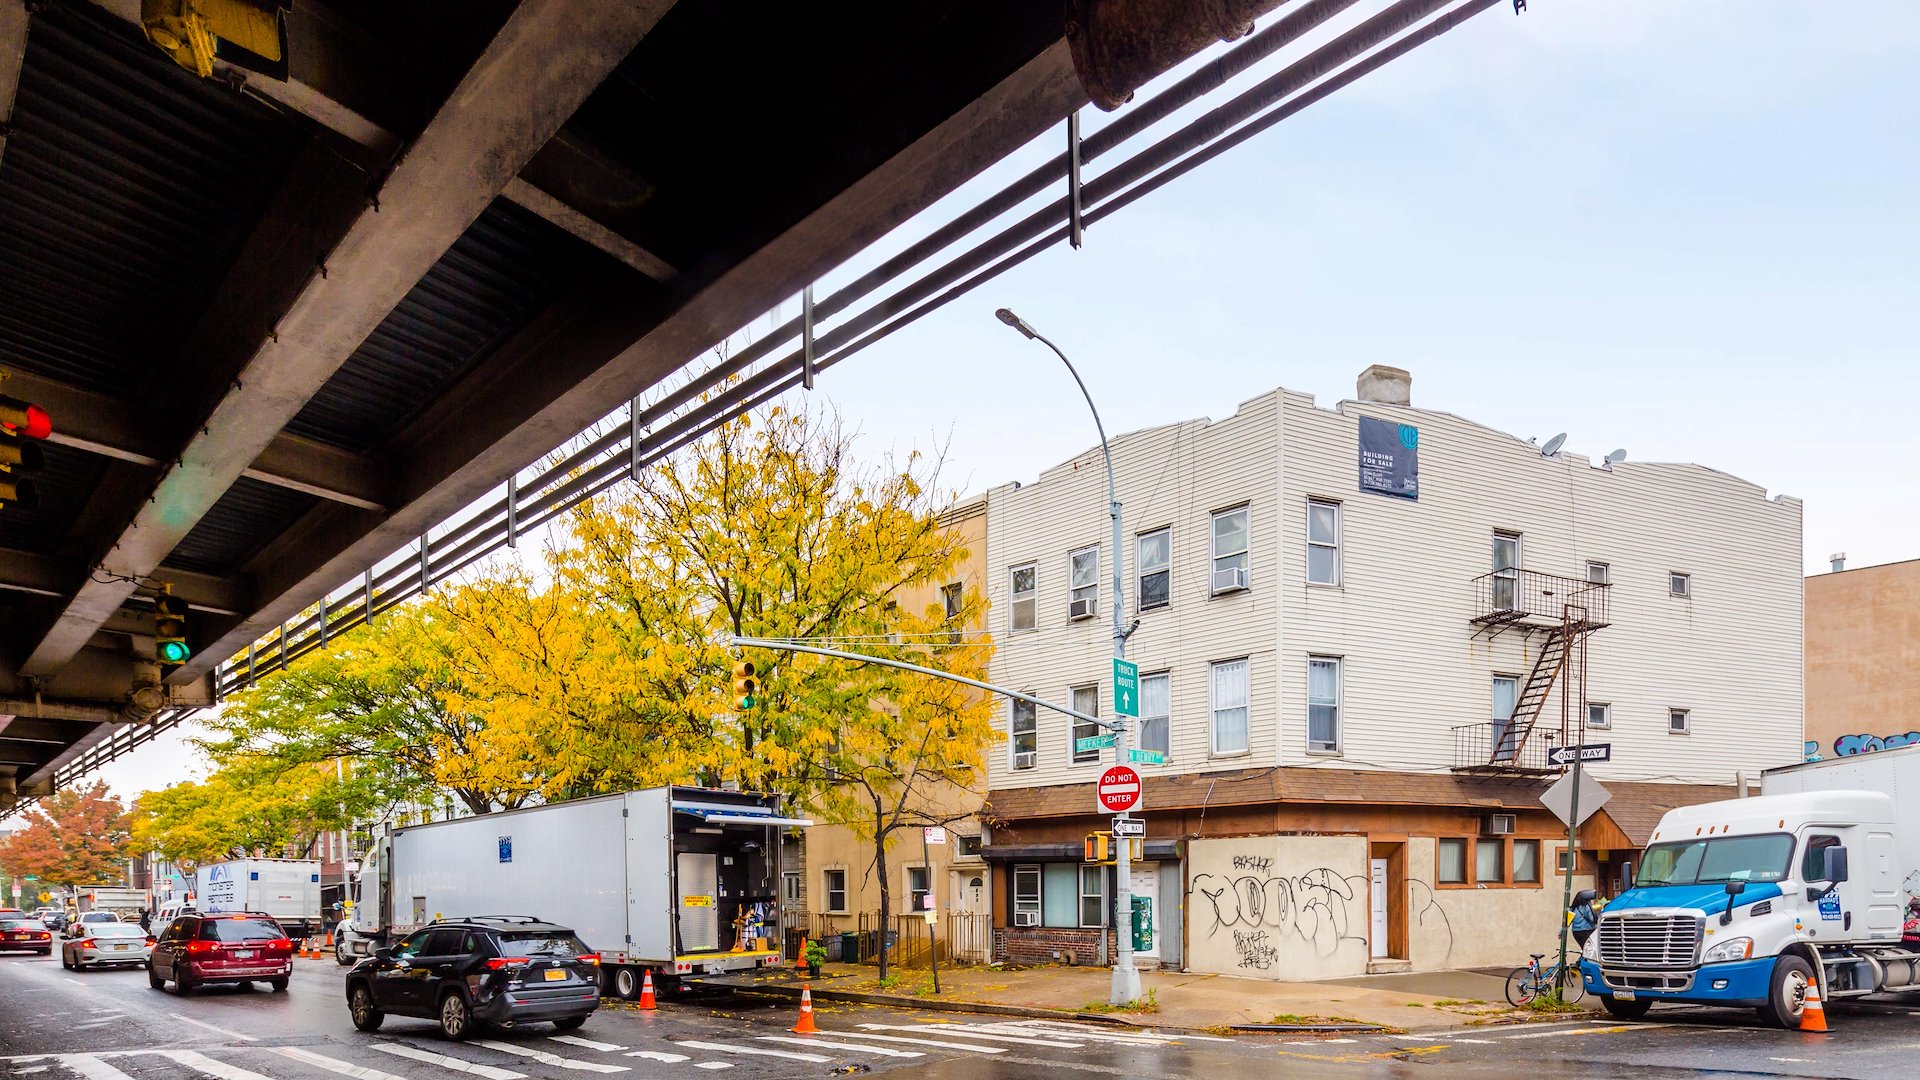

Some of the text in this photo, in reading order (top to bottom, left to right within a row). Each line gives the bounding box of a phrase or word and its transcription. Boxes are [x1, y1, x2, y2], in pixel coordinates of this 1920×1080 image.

[1363, 451, 1393, 461] BUILDING
[1117, 663, 1134, 676] TRUCK
[1117, 677, 1134, 688] ROUTE
[1077, 737, 1106, 751] MEEKER
[1136, 752, 1156, 762] HENRY
[1581, 749, 1601, 757] WAY
[1105, 773, 1133, 784] DO NOT
[1107, 794, 1132, 804] ENTER
[1117, 824, 1141, 832] ONE WAY
